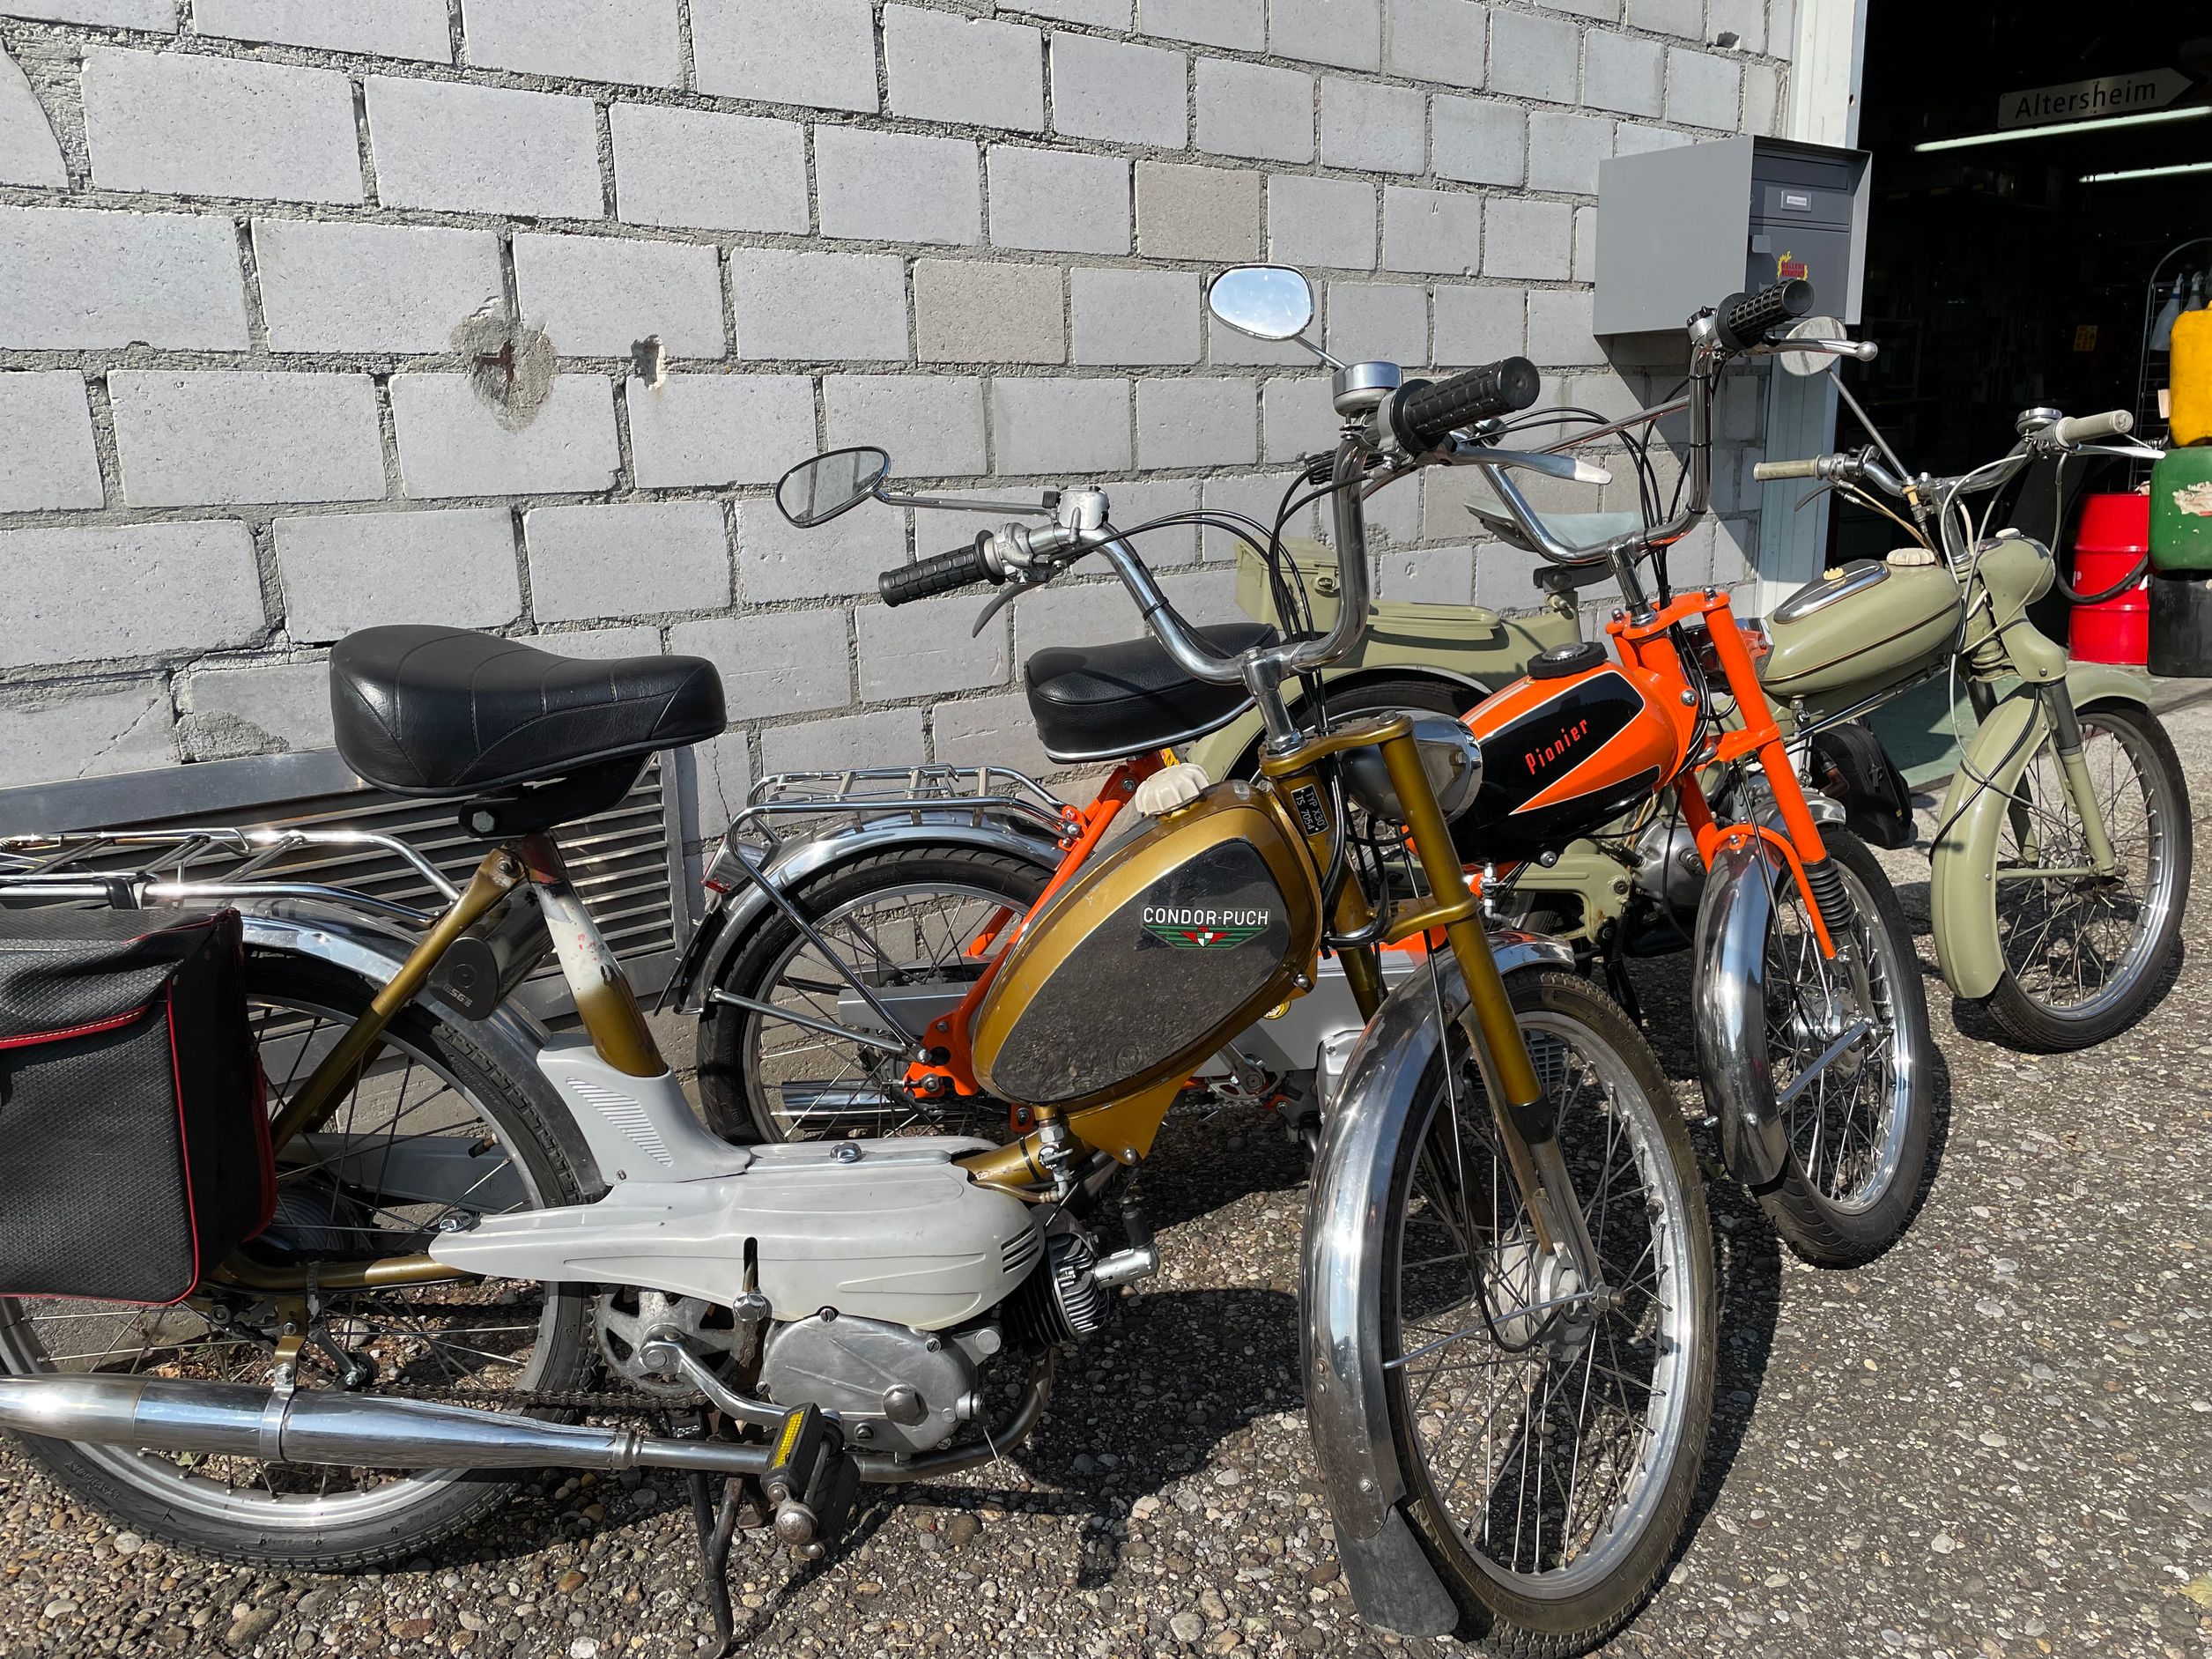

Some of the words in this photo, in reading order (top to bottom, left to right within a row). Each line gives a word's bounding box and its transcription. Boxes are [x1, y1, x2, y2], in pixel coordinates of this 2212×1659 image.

[2014, 79, 2157, 120] Altersheim
[1525, 719, 1587, 775] Pionier
[1295, 796, 1306, 806] TS
[1306, 791, 1318, 807] TYP
[1300, 809, 1315, 830] 7054
[1143, 907, 1269, 926] CONDOR-PUCH
[443, 983, 473, 1008] ESGE
